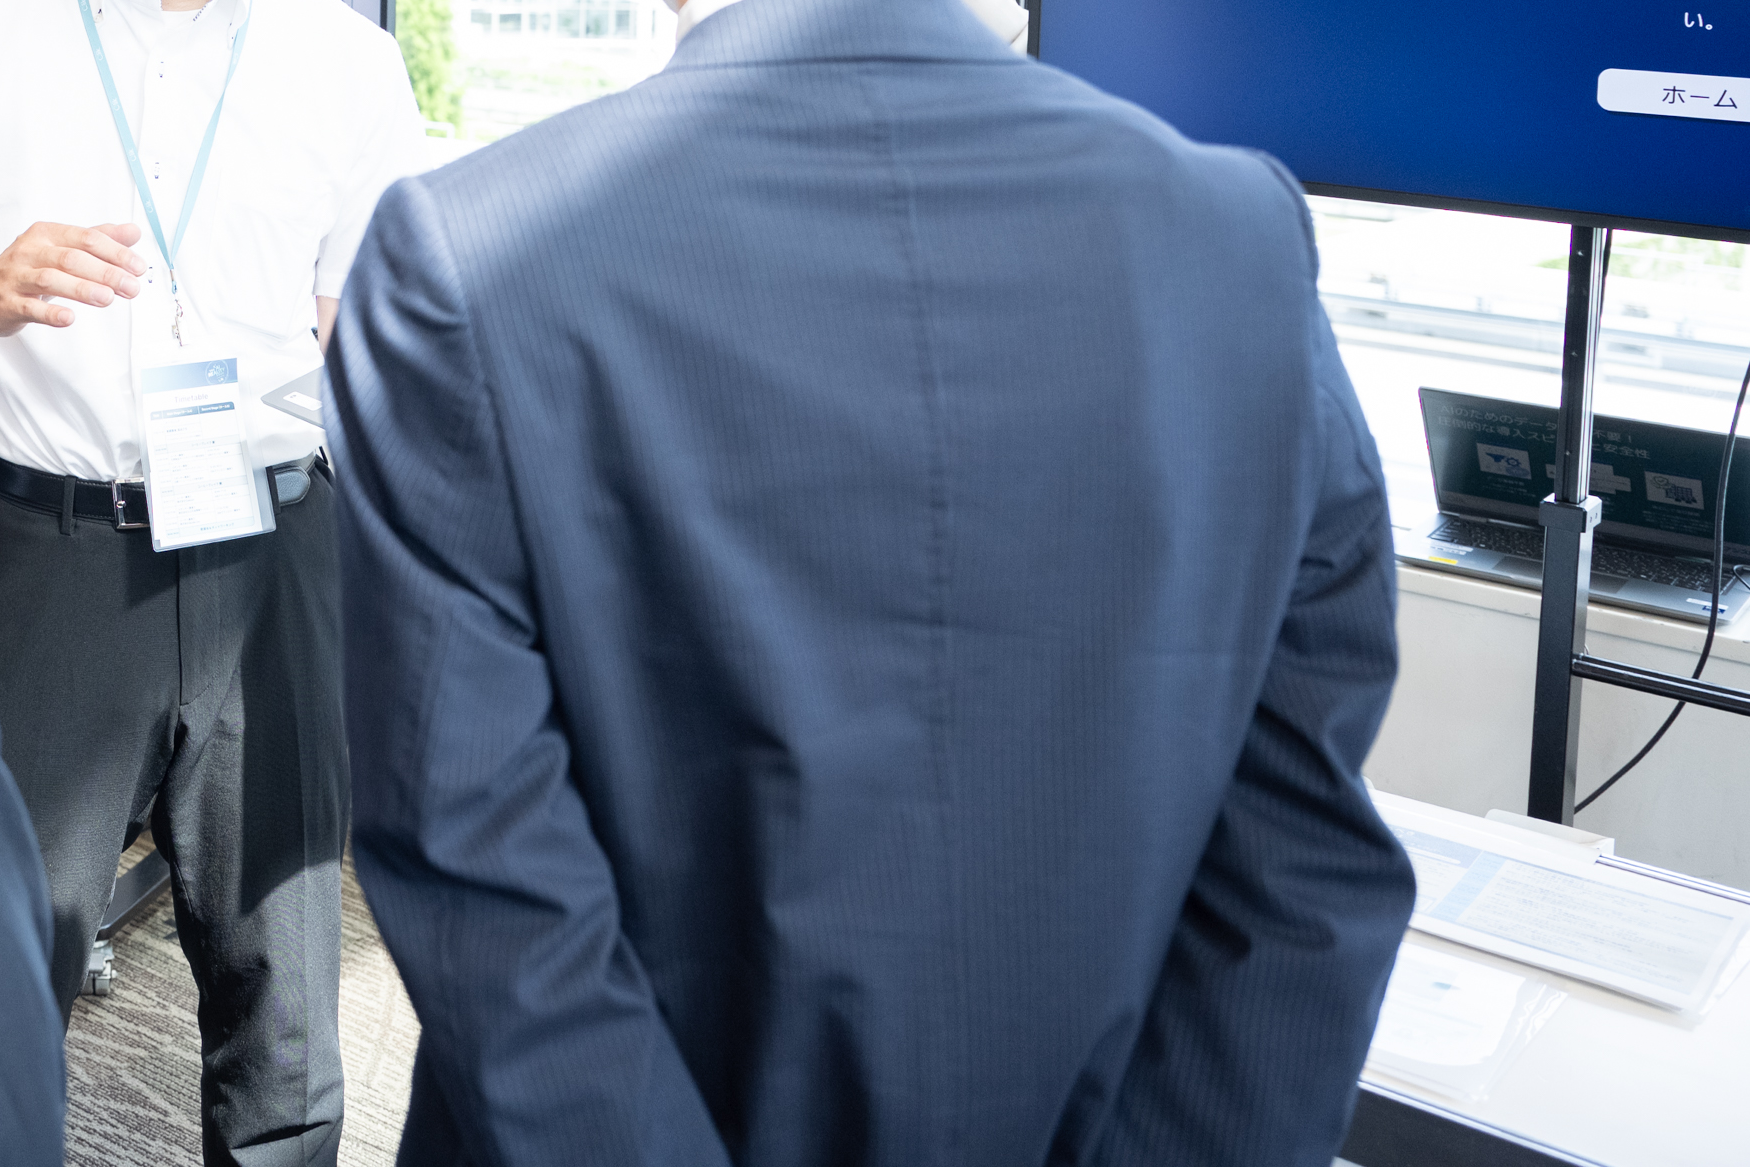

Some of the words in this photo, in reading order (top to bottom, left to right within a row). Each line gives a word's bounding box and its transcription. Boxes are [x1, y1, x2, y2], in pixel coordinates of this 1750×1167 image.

[1683, 12, 1713, 31] い。
[1662, 85, 1739, 110] ホーム
[175, 393, 209, 403] Timetable
